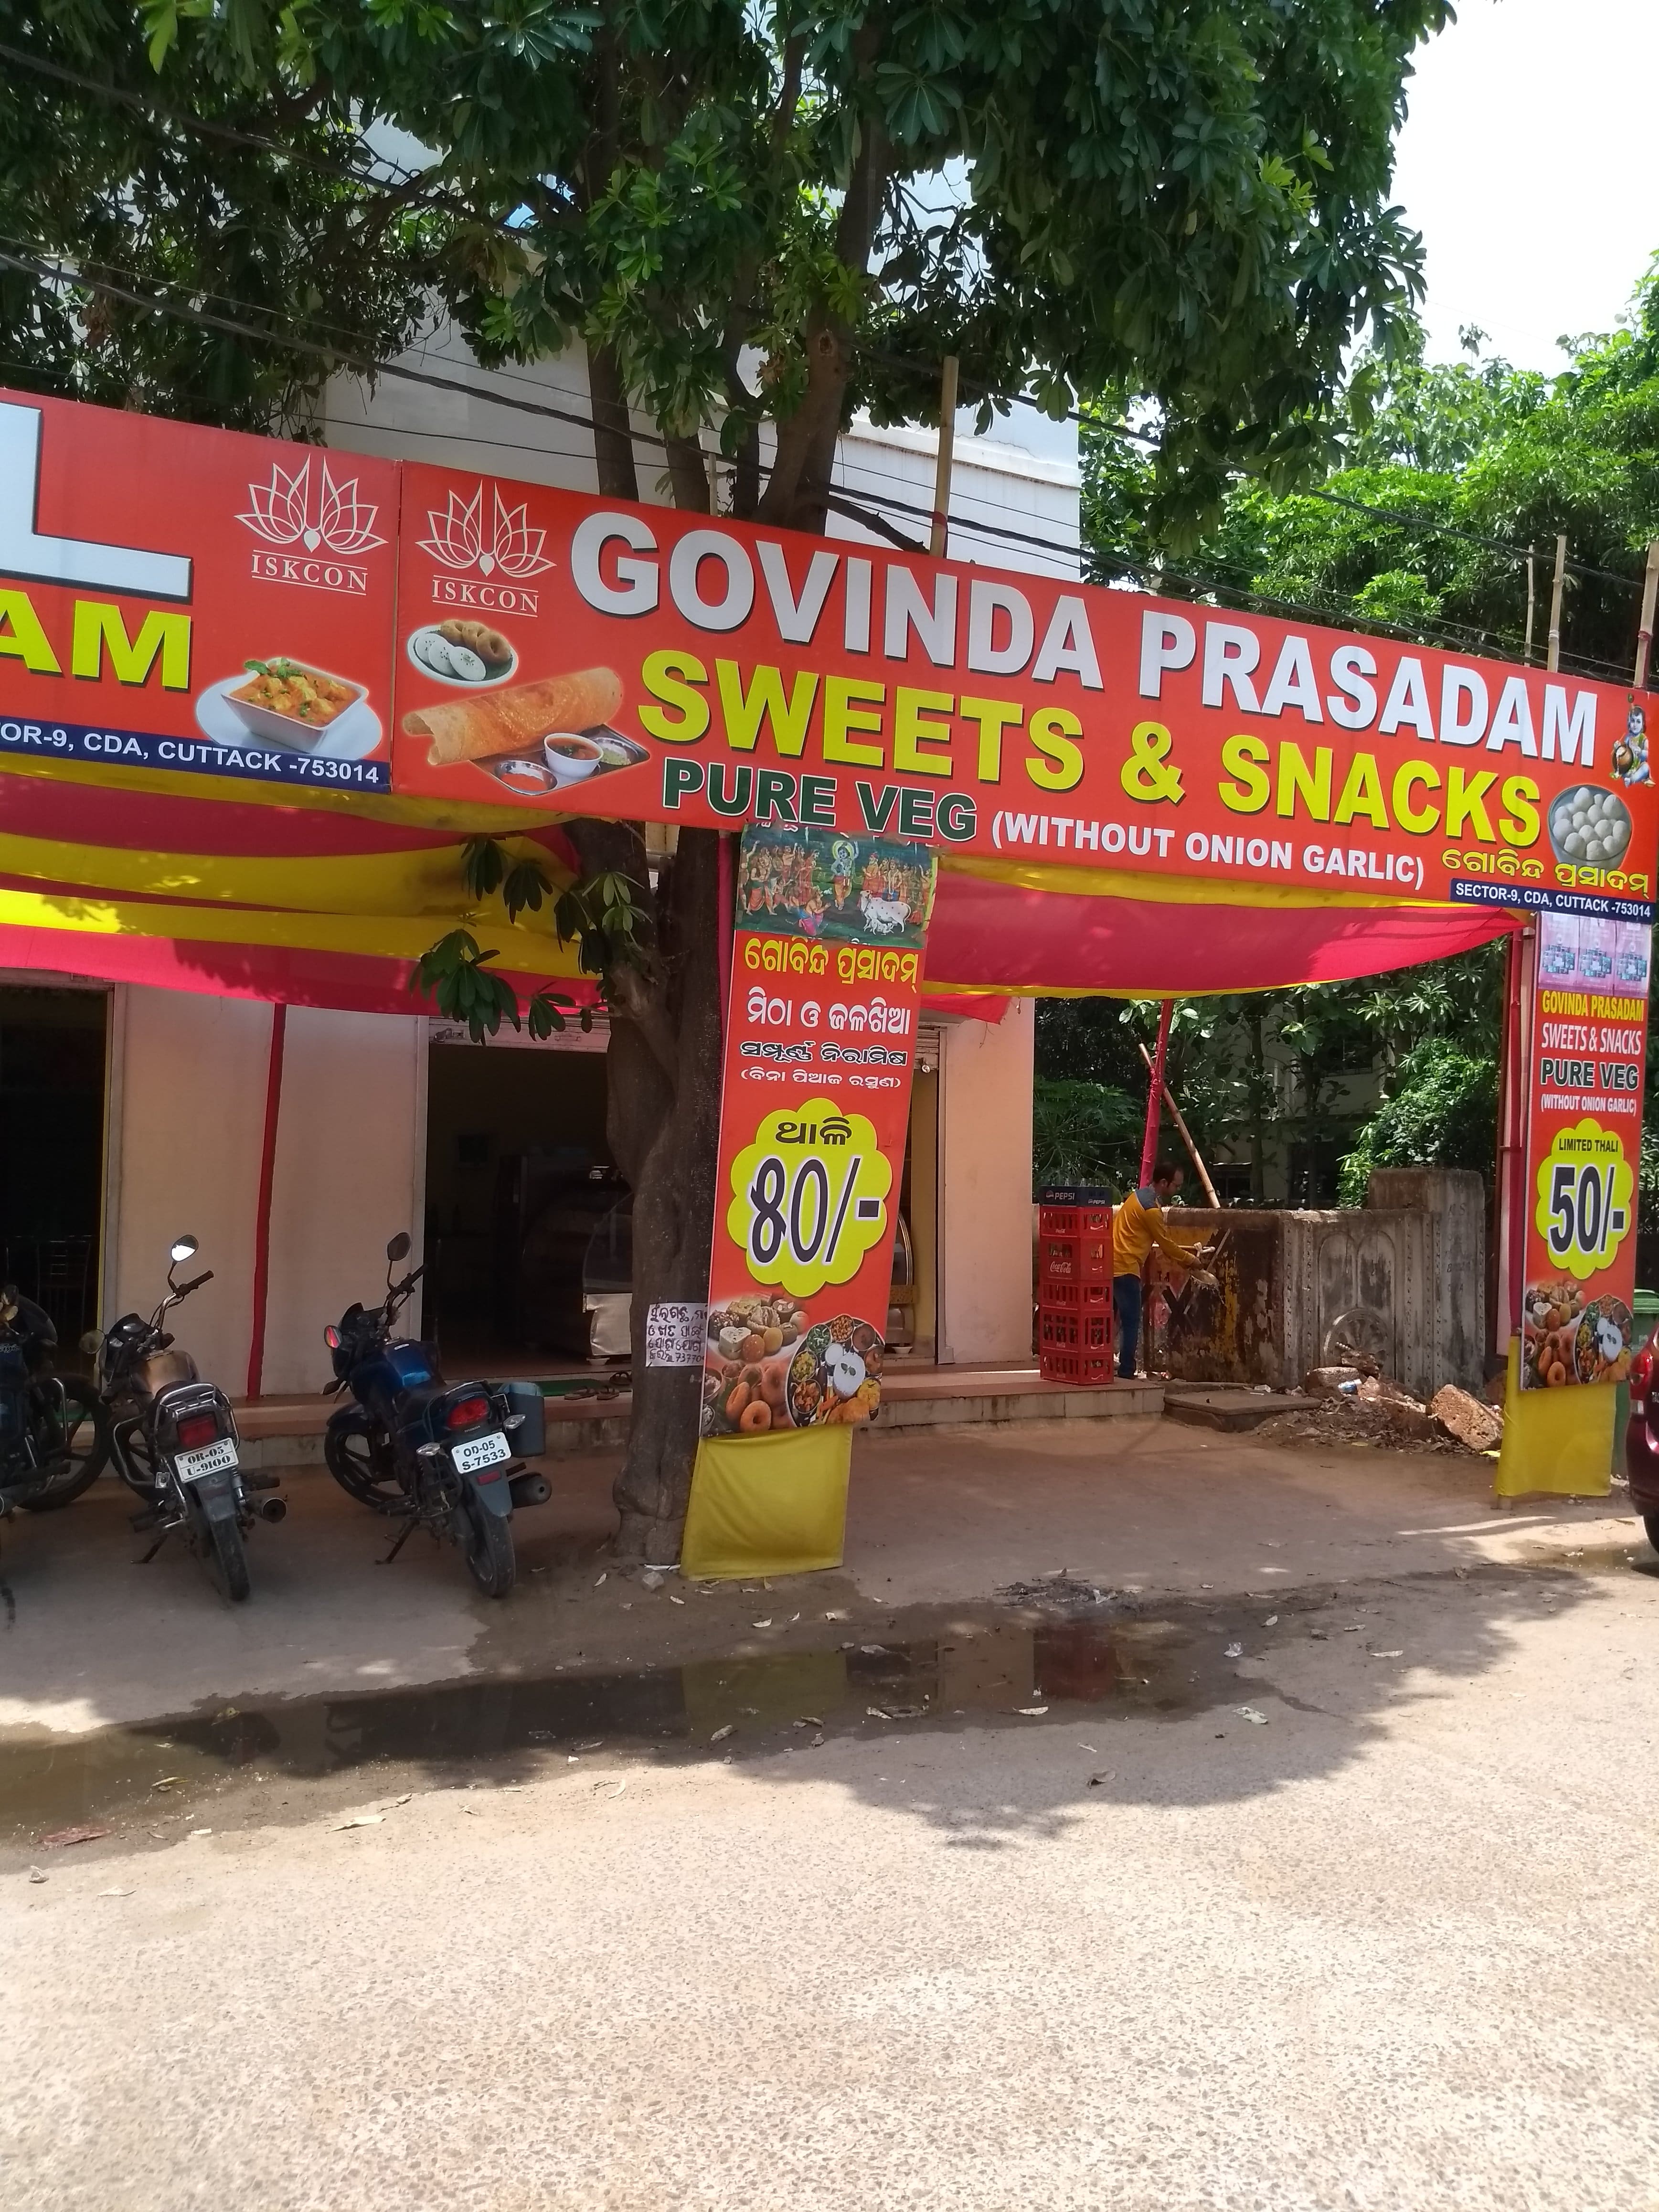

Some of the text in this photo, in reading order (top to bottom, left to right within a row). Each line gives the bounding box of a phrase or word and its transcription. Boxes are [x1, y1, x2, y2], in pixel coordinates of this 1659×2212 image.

[252, 554, 368, 591] ISKCON
[432, 579, 539, 613] ISKCON
[571, 511, 1597, 767] GOVINDA PRASADAM
[0, 723, 379, 784] OR-9, CDA, CUTTACK -753014
[638, 649, 1541, 847] SWEETS & SNACKS
[662, 756, 838, 827] PURE
[855, 780, 978, 842] VEG
[992, 810, 1175, 858] (WITHOUT
[1185, 832, 1292, 870] ONION
[1303, 844, 1424, 890] GARLIC)
[1441, 848, 1545, 879] ଗୋବିନ୍ଦ
[1455, 883, 1651, 918] SECTOR-9, CDA, CUTTACK -753014
[747, 986, 911, 1035] ମିଠା ଓ ଜଳଖିଆ
[1542, 990, 1644, 1021] GOVINDA PRASADAM
[820, 1042, 908, 1066] ନିରାମିଷ
[1542, 1022, 1642, 1055] SWEETS & SNACKS
[741, 1066, 901, 1089] (ବିନା ପିଆଜ ରସୁଣ)
[1540, 1057, 1639, 1091] PURE VEG
[1541, 1094, 1637, 1117] (WITHOUT ONION GARLIC)
[775, 1116, 852, 1146] ଥାଳି
[1559, 1138, 1618, 1152] LIMITED THALI
[747, 1155, 881, 1266] 80/-
[1054, 1192, 1075, 1201] PEPSI
[1548, 1165, 1625, 1253] 50/-
[675, 1352, 704, 1363] 73770
[187, 1446, 224, 1465] OR-05
[462, 1448, 506, 1471] S-7533
[463, 1440, 496, 1457] OD-05
[186, 1455, 231, 1476] U-9100
